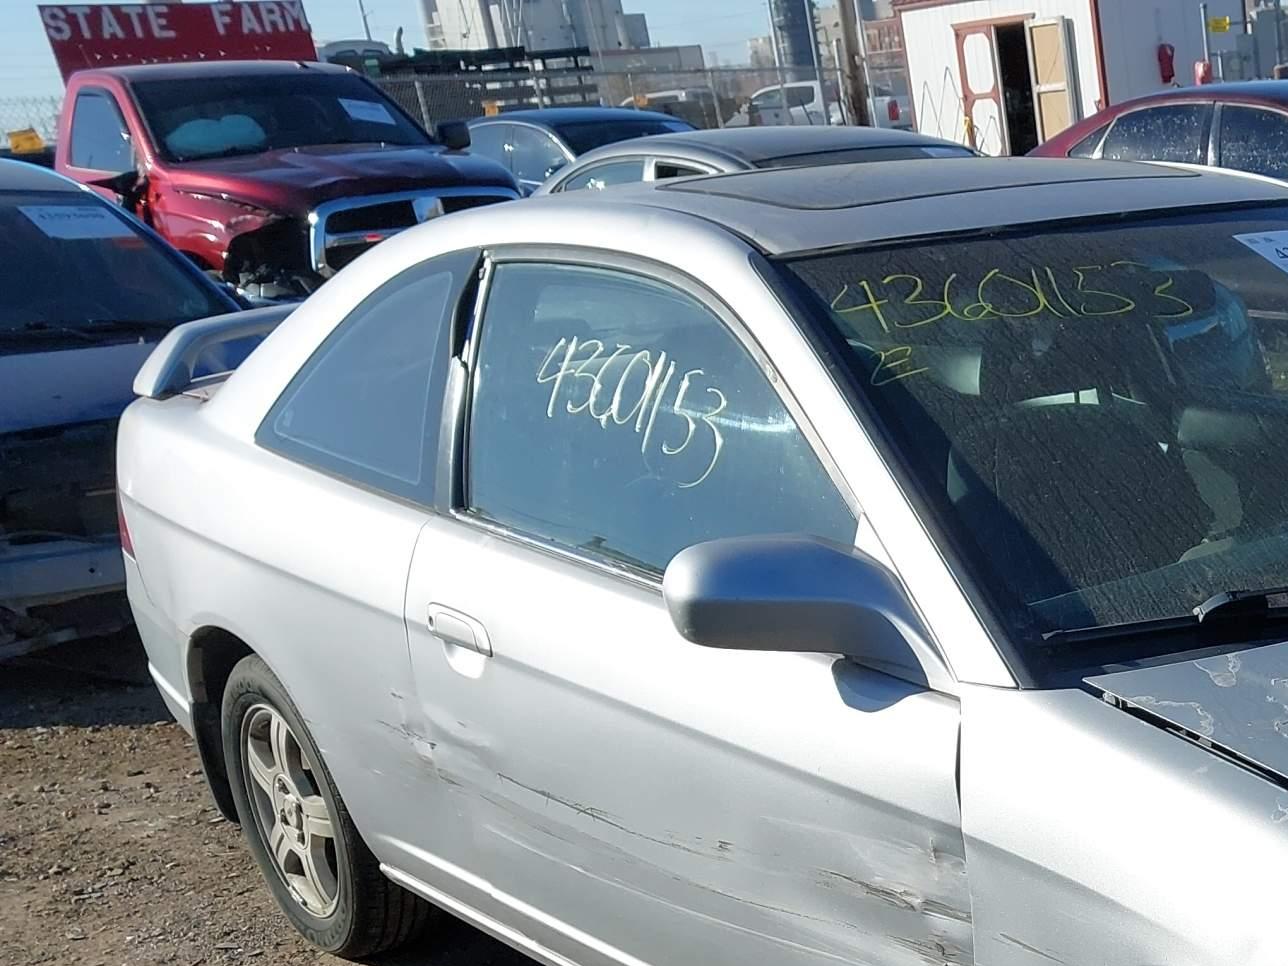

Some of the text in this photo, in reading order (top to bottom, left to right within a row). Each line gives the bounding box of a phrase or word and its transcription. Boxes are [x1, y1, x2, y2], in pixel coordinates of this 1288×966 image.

[41, 0, 312, 41] STATE FARM
[830, 260, 1194, 333] 43601153
[536, 335, 728, 488] 43601153
